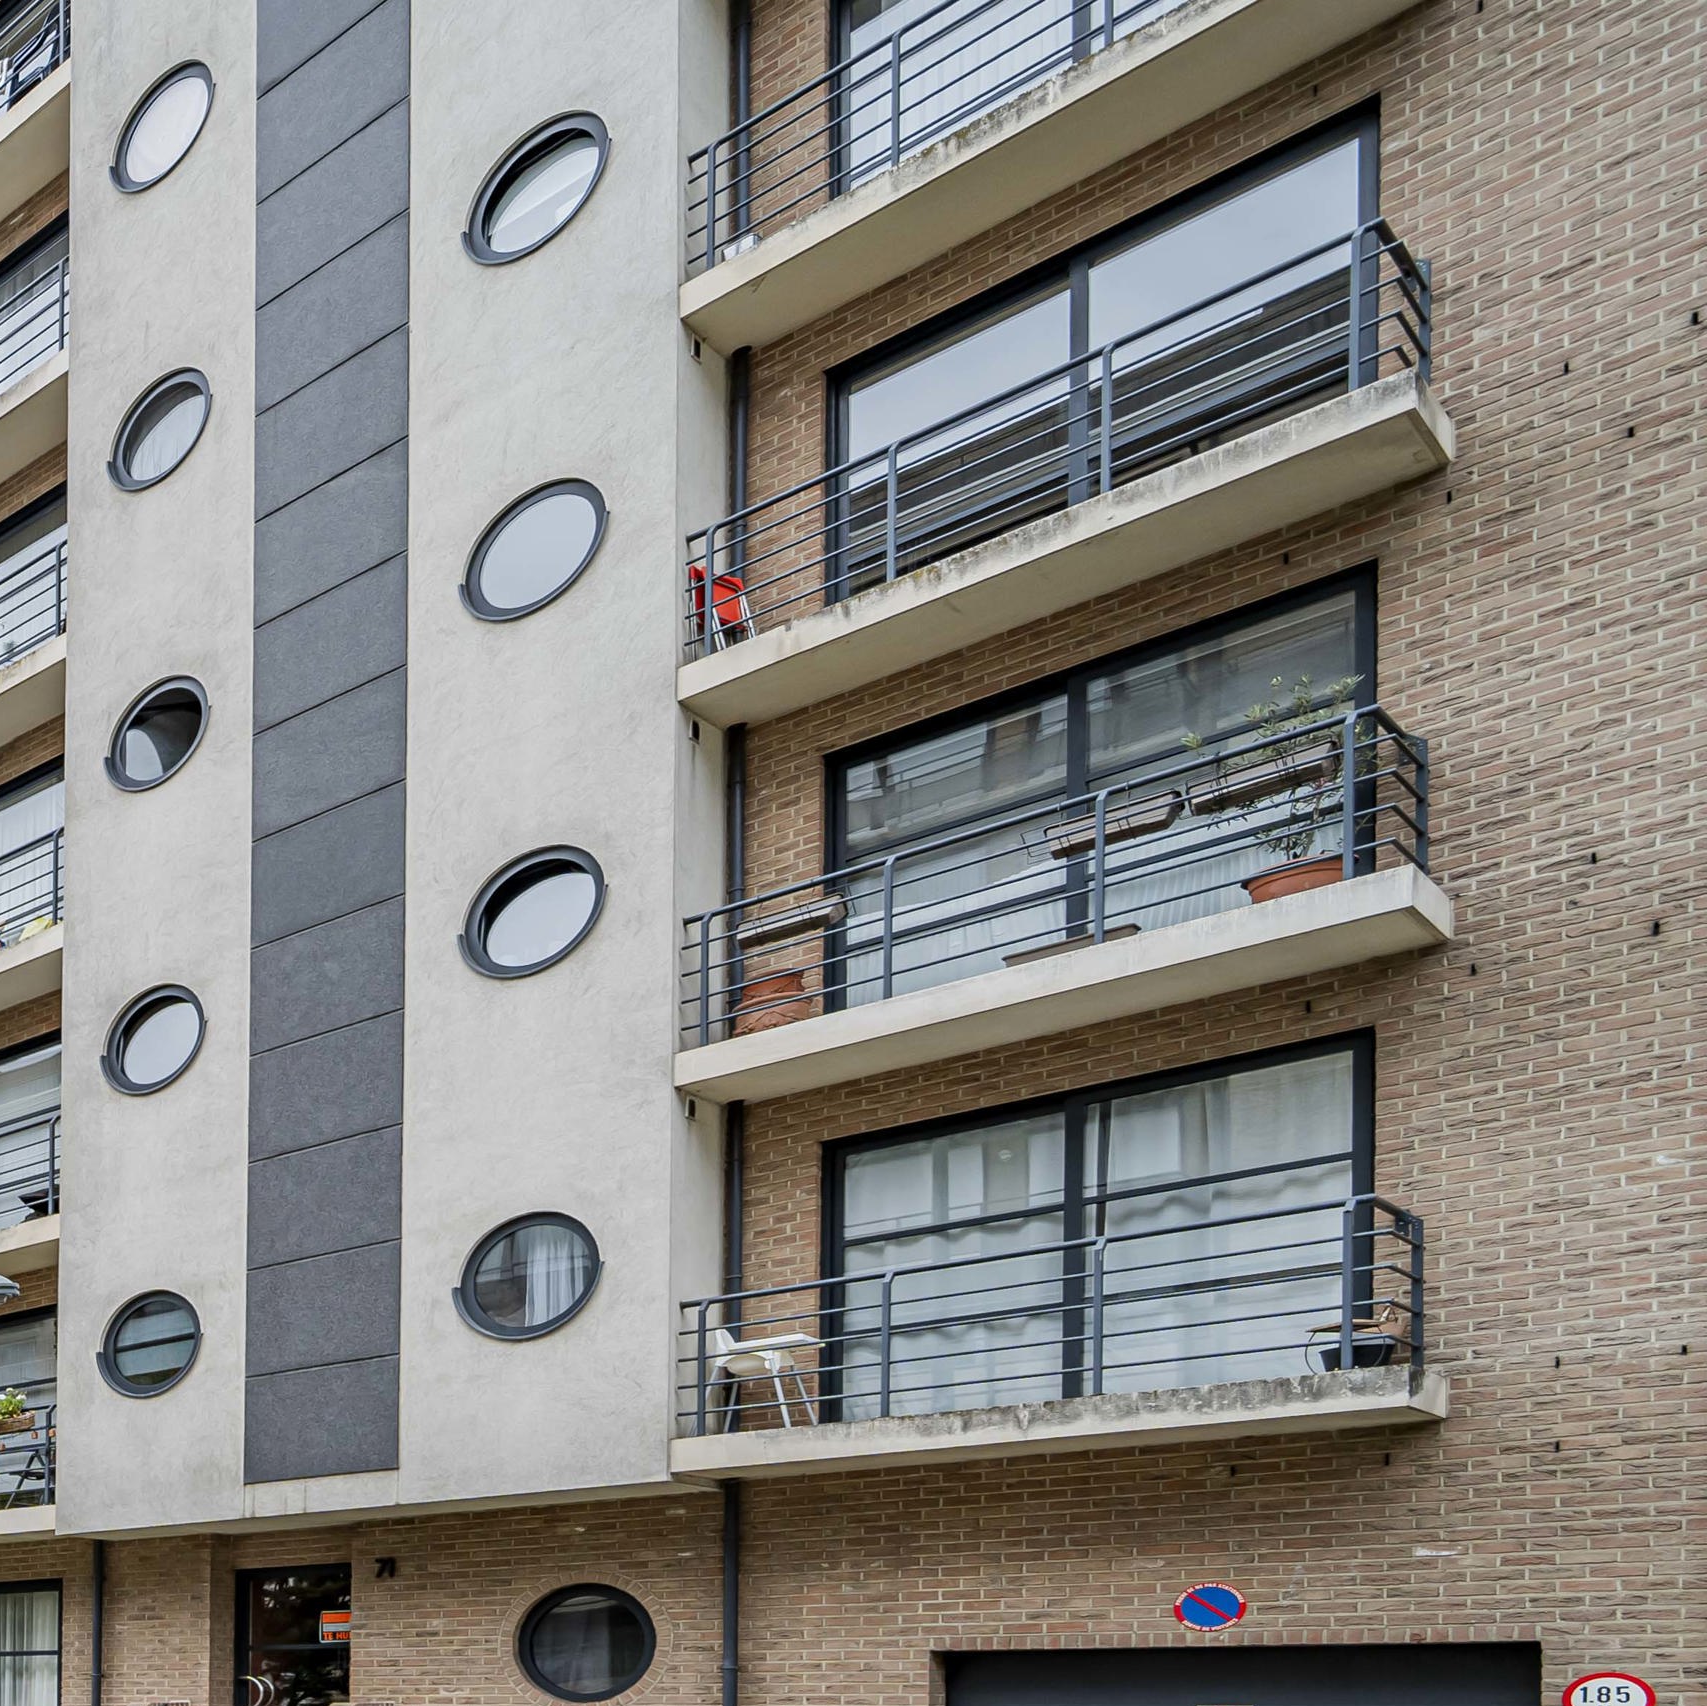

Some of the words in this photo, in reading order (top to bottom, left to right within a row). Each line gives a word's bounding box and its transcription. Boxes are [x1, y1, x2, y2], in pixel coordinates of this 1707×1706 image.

[375, 1556, 396, 1579] 71
[323, 1632, 333, 1641] TE
[336, 1631, 351, 1640] HU
[1579, 1685, 1630, 1704] 1.85
